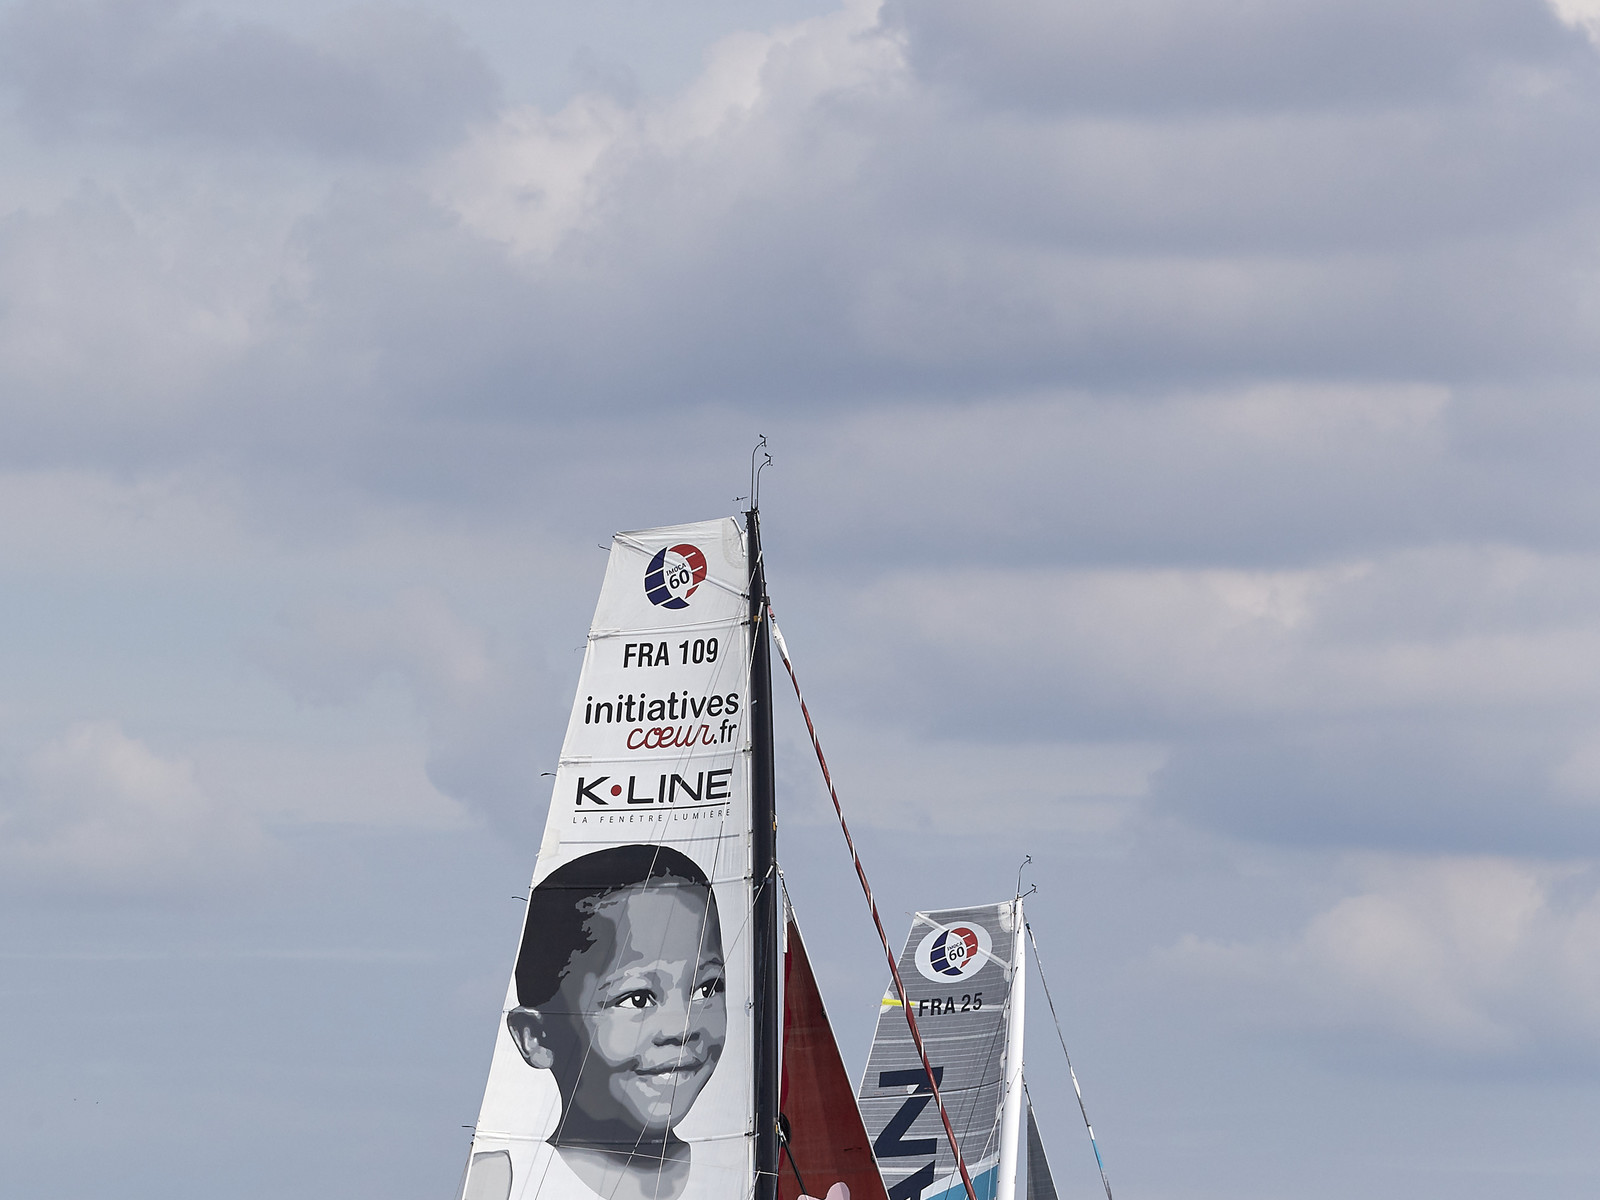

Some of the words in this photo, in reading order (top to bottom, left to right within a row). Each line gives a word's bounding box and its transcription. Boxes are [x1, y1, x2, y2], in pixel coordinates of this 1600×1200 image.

[666, 562, 686, 576] IMOCA
[669, 569, 690, 589] 60
[623, 642, 670, 668] FRA
[679, 638, 718, 665] 109
[585, 691, 739, 724] initiatives
[573, 816, 588, 824] LA
[600, 814, 663, 823] FENÊTRE
[949, 947, 964, 961] 60
[918, 997, 957, 1017] FRA
[960, 992, 983, 1012] 25
